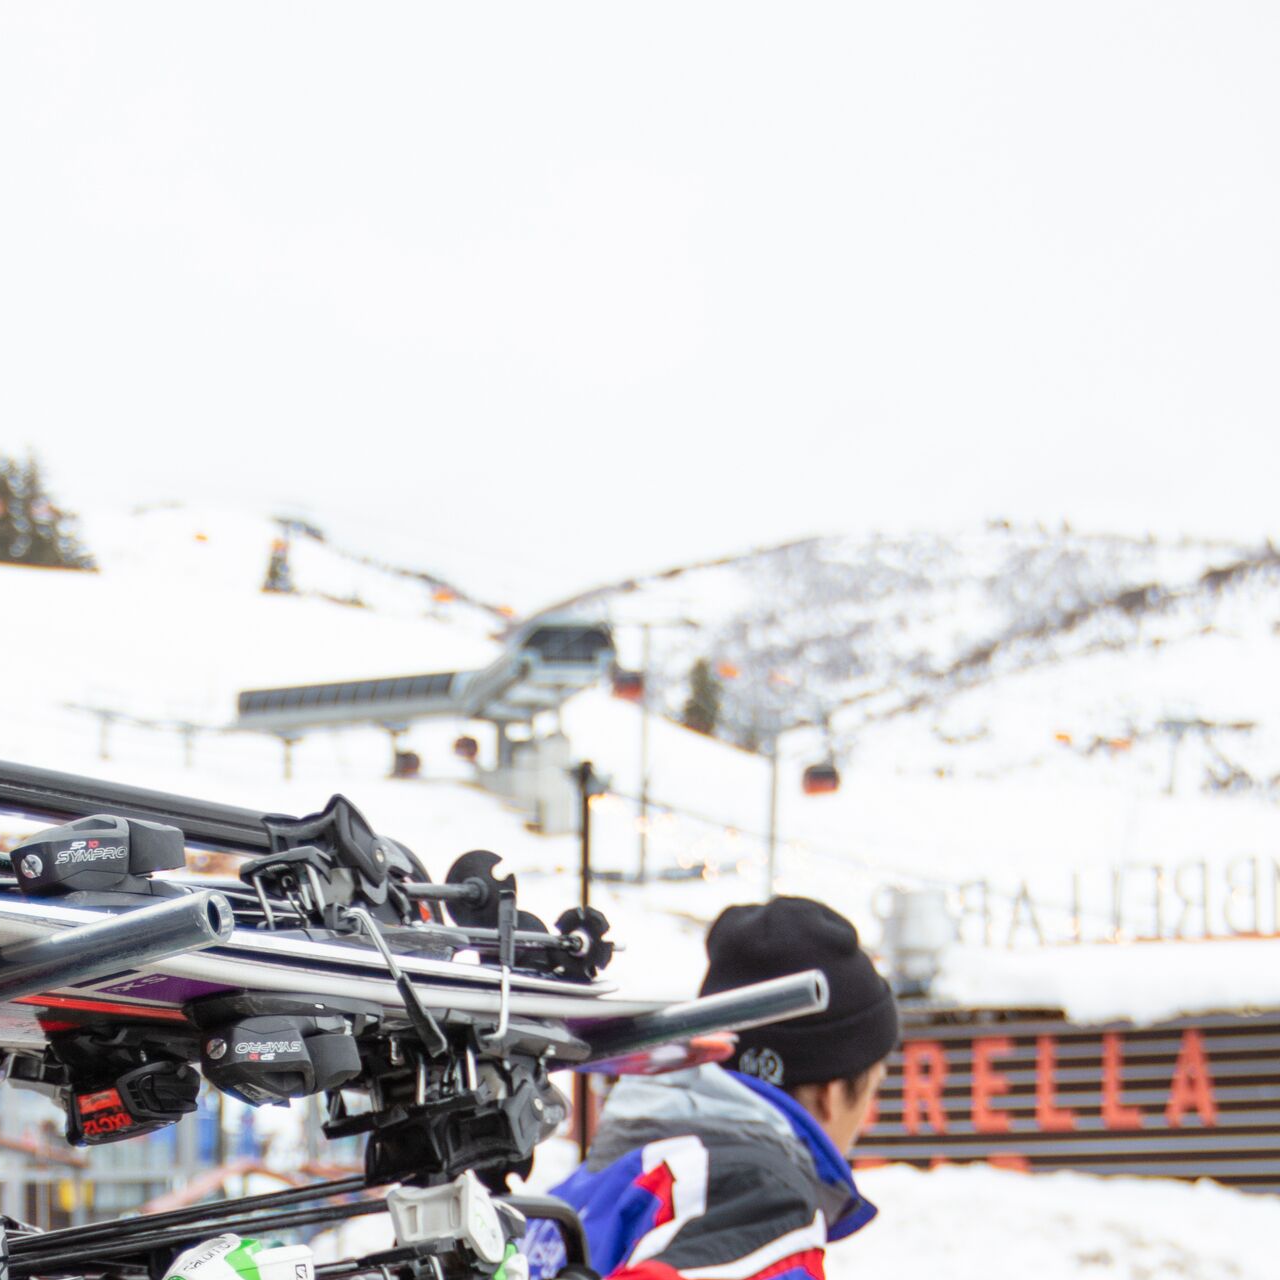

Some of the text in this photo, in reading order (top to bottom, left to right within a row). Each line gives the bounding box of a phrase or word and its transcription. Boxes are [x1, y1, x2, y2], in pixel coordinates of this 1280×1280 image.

[54, 846, 128, 865] SYMPRO
[235, 1040, 302, 1054] SYMPRO
[858, 1028, 1217, 1137] RELLA
